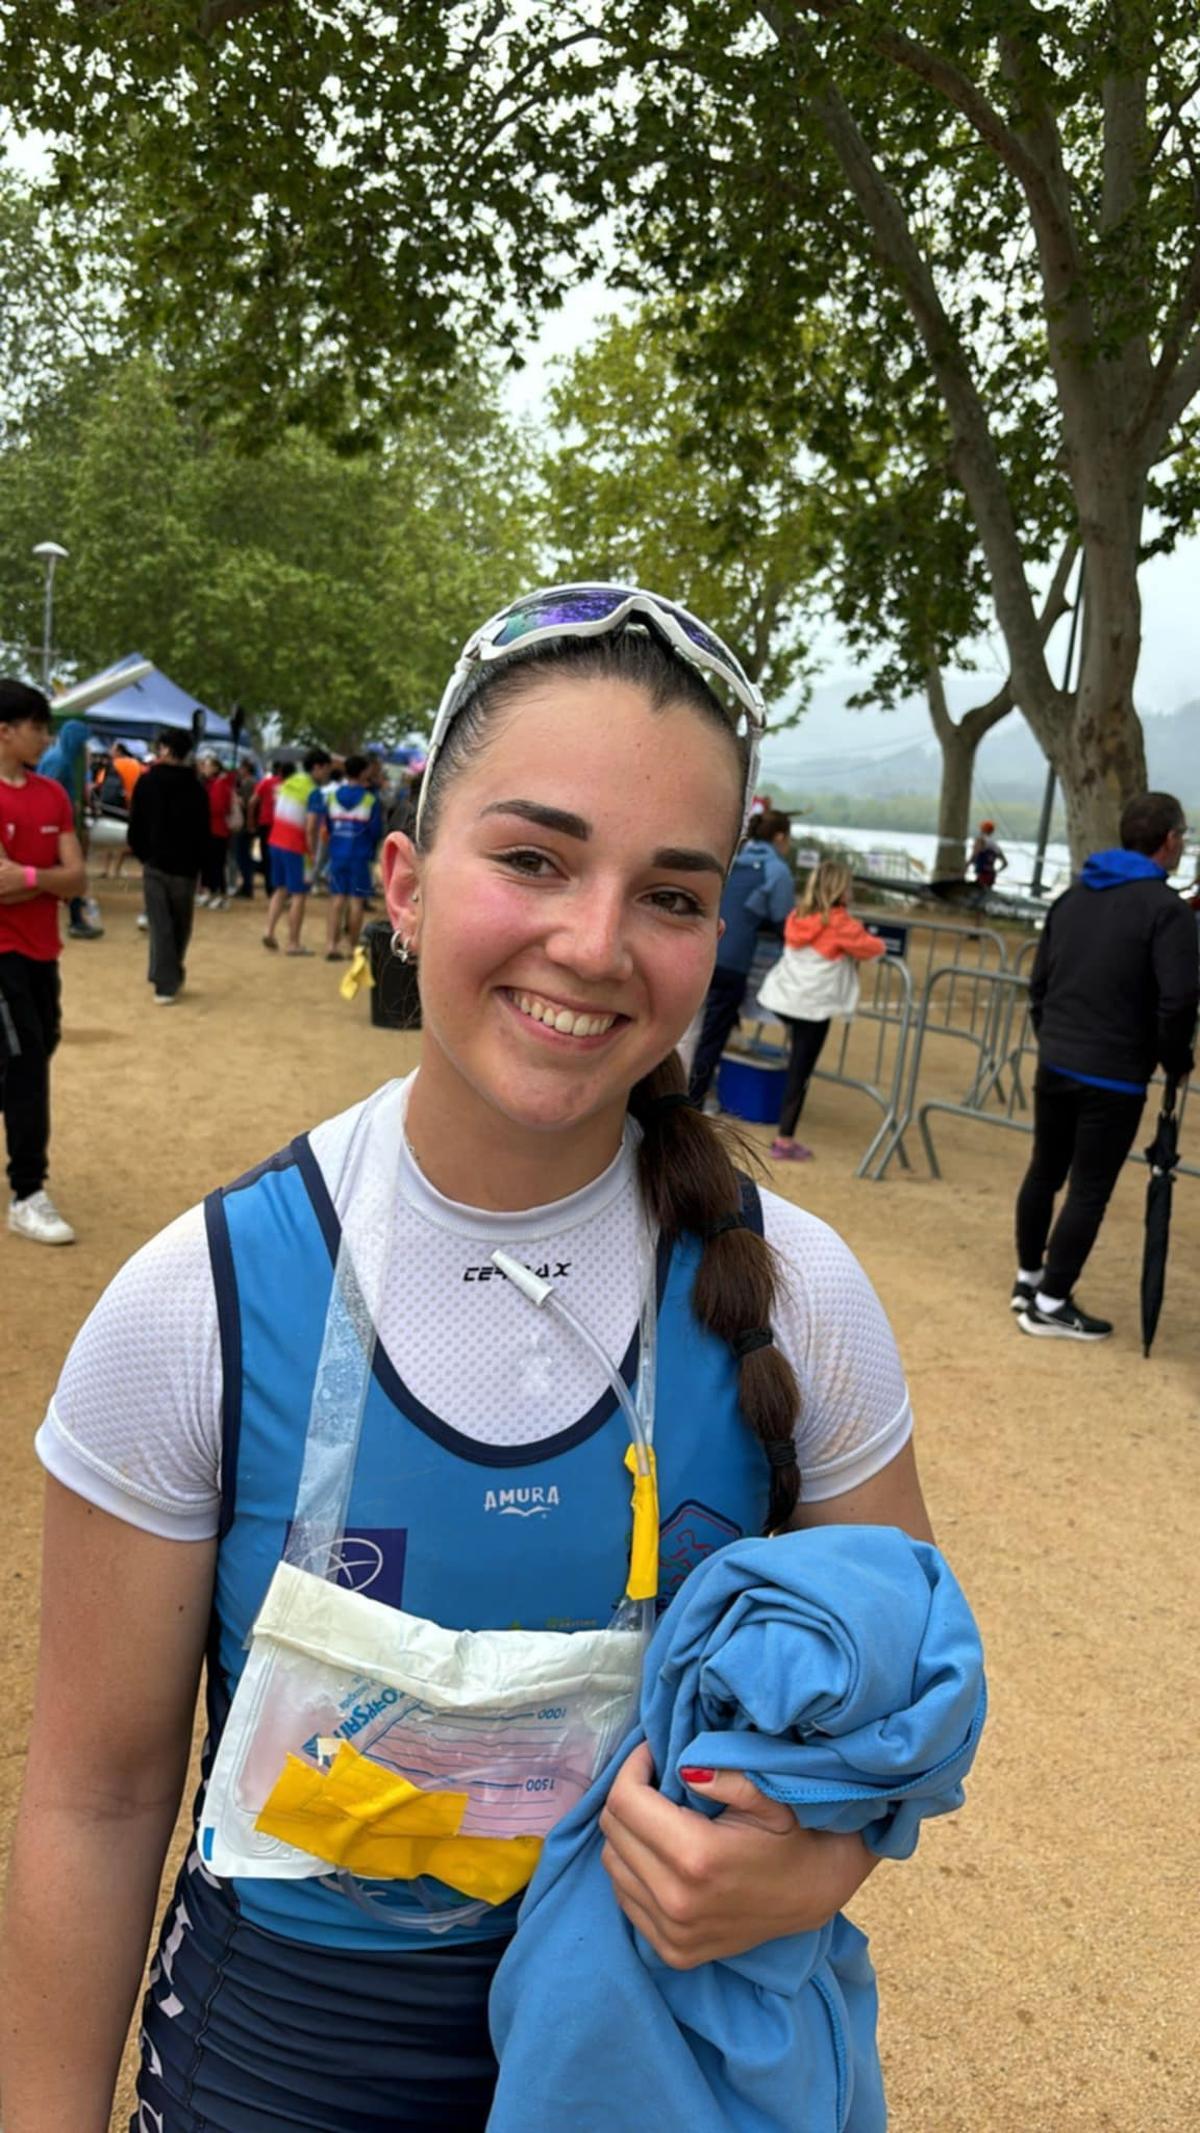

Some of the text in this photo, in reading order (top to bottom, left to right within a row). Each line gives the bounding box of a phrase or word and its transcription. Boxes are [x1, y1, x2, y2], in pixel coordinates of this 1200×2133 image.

[484, 1485, 560, 1512] AMURA
[537, 1707, 567, 1720] 1000
[526, 1779, 555, 1792] 1500
